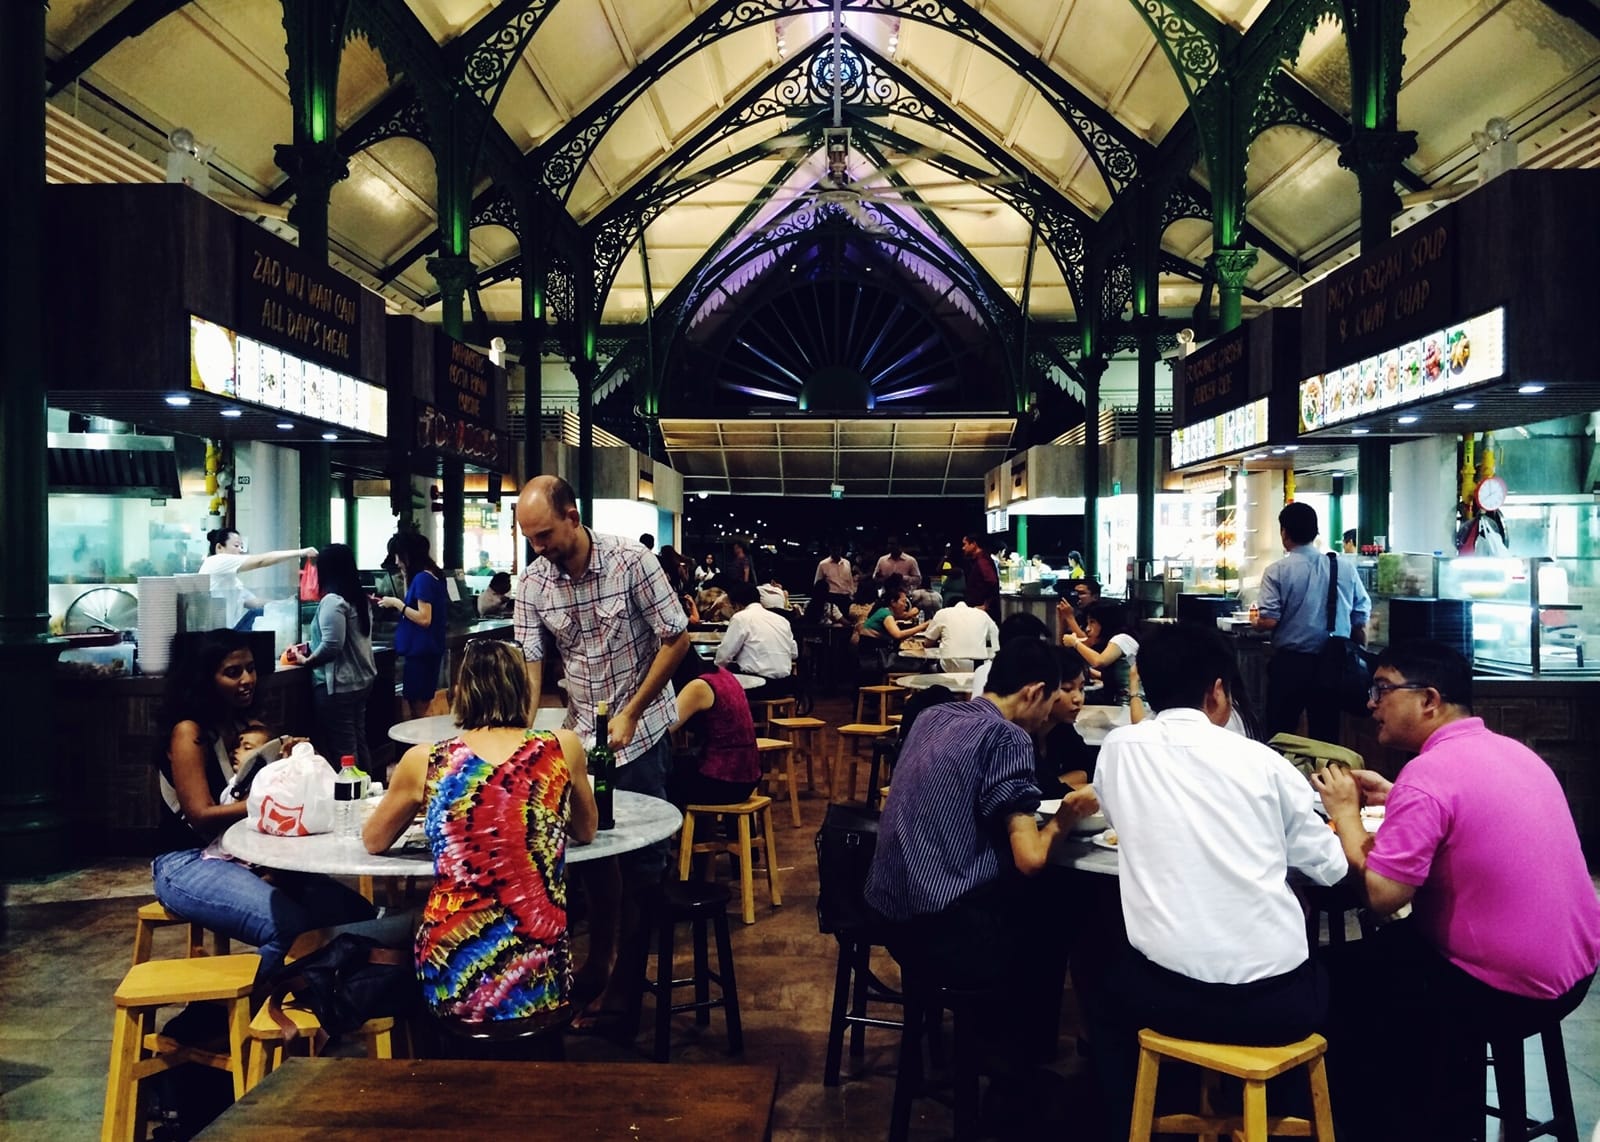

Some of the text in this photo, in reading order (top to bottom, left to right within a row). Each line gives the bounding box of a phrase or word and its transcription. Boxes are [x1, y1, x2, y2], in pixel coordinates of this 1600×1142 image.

[253, 249, 356, 325] ZAO WU WAN CAN
[1361, 251, 1402, 294] ORGAN
[1411, 226, 1447, 271] SOUP
[262, 298, 350, 359] ALL DAY'S MEAL
[1395, 279, 1430, 319] CHAP
